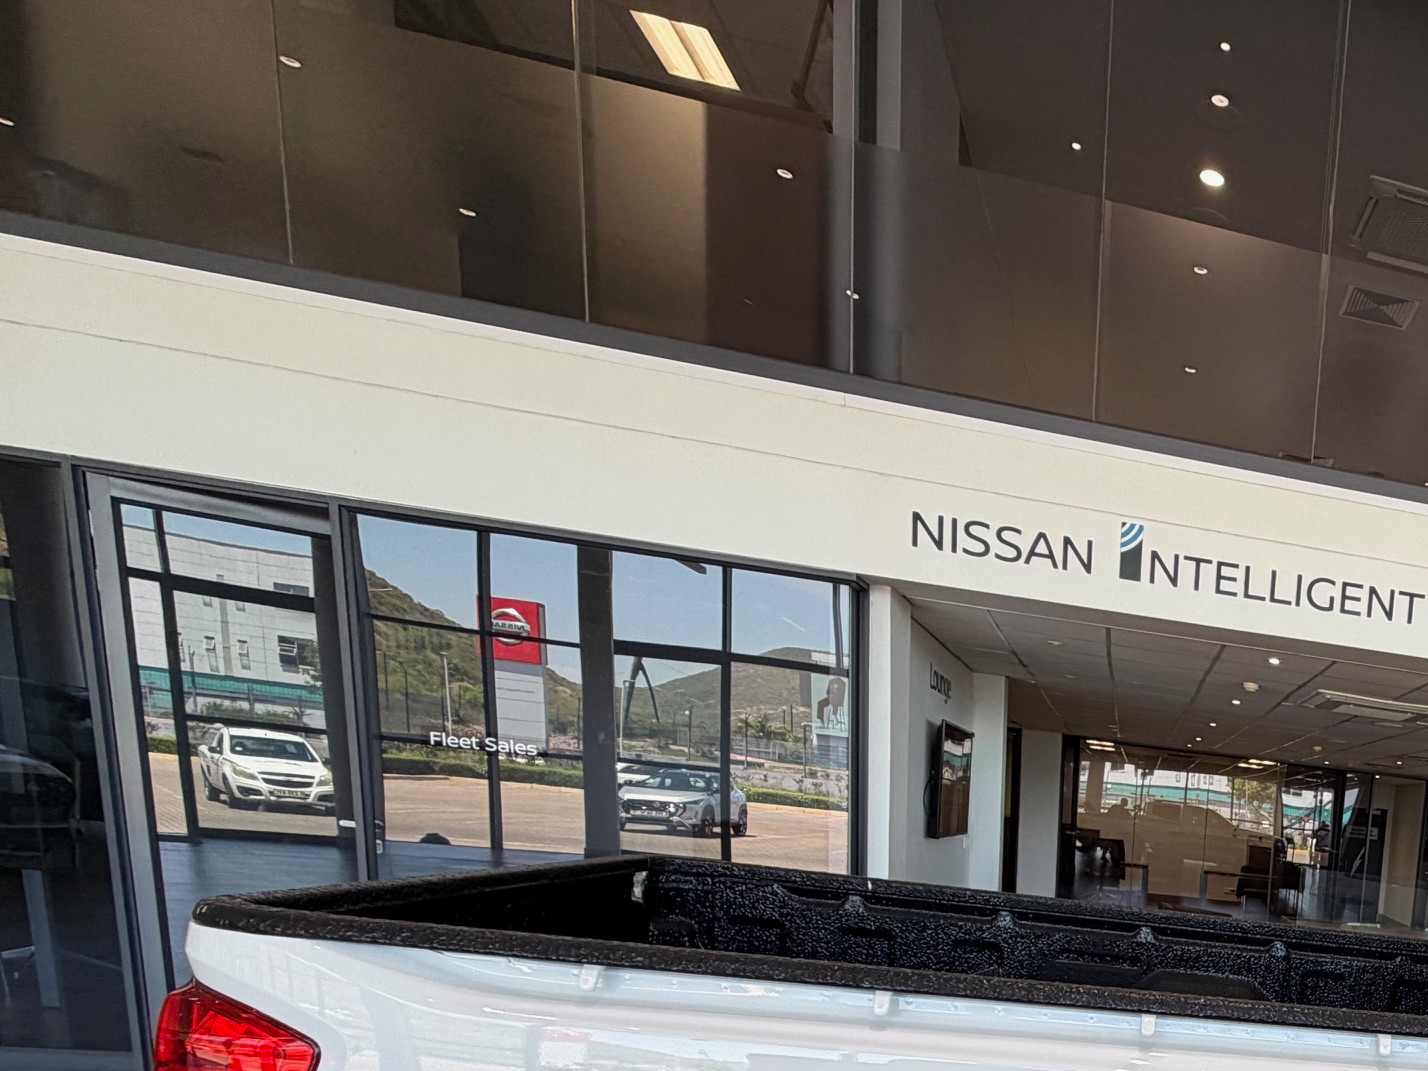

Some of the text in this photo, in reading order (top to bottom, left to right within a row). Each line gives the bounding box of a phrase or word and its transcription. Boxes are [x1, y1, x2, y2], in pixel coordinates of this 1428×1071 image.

[910, 510, 1095, 575] NISSAN
[1119, 521, 1426, 625] INTELLIGENT
[929, 661, 952, 705] Lounge
[429, 731, 538, 756] Fleet Sales
